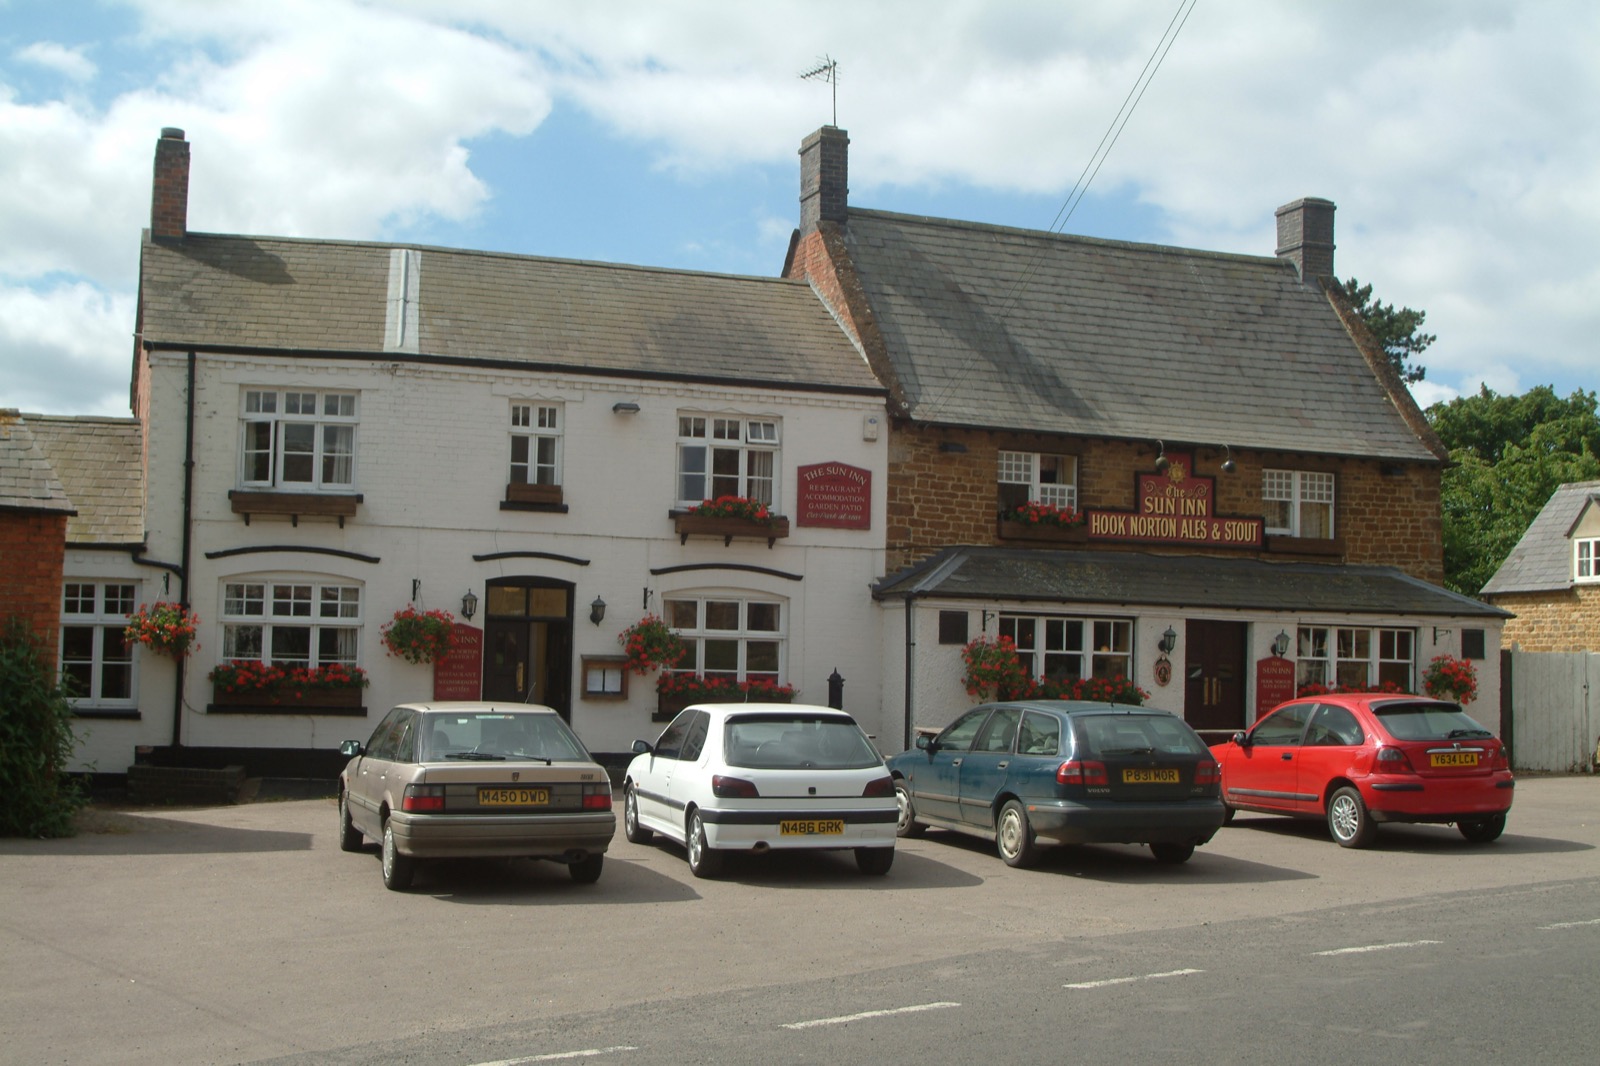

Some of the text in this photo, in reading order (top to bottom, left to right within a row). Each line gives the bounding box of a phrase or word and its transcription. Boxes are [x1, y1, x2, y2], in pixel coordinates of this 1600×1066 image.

[803, 466, 867, 486] THE SUN INN
[809, 484, 862, 493] RESTAURANT
[1165, 483, 1186, 499] The
[804, 493, 865, 503] ACCOMMODATION
[808, 502, 862, 512] GARDEN PATIO
[1144, 496, 1207, 517] SUN INN
[1091, 514, 1258, 542] HOOK NORTON ALES & STOUT
[461, 635, 478, 644] INN
[1434, 754, 1475, 765] Y634 LCA
[1154, 770, 1176, 780] MOR
[481, 789, 547, 803] M450 DWD
[781, 821, 843, 834] N486 GRK
